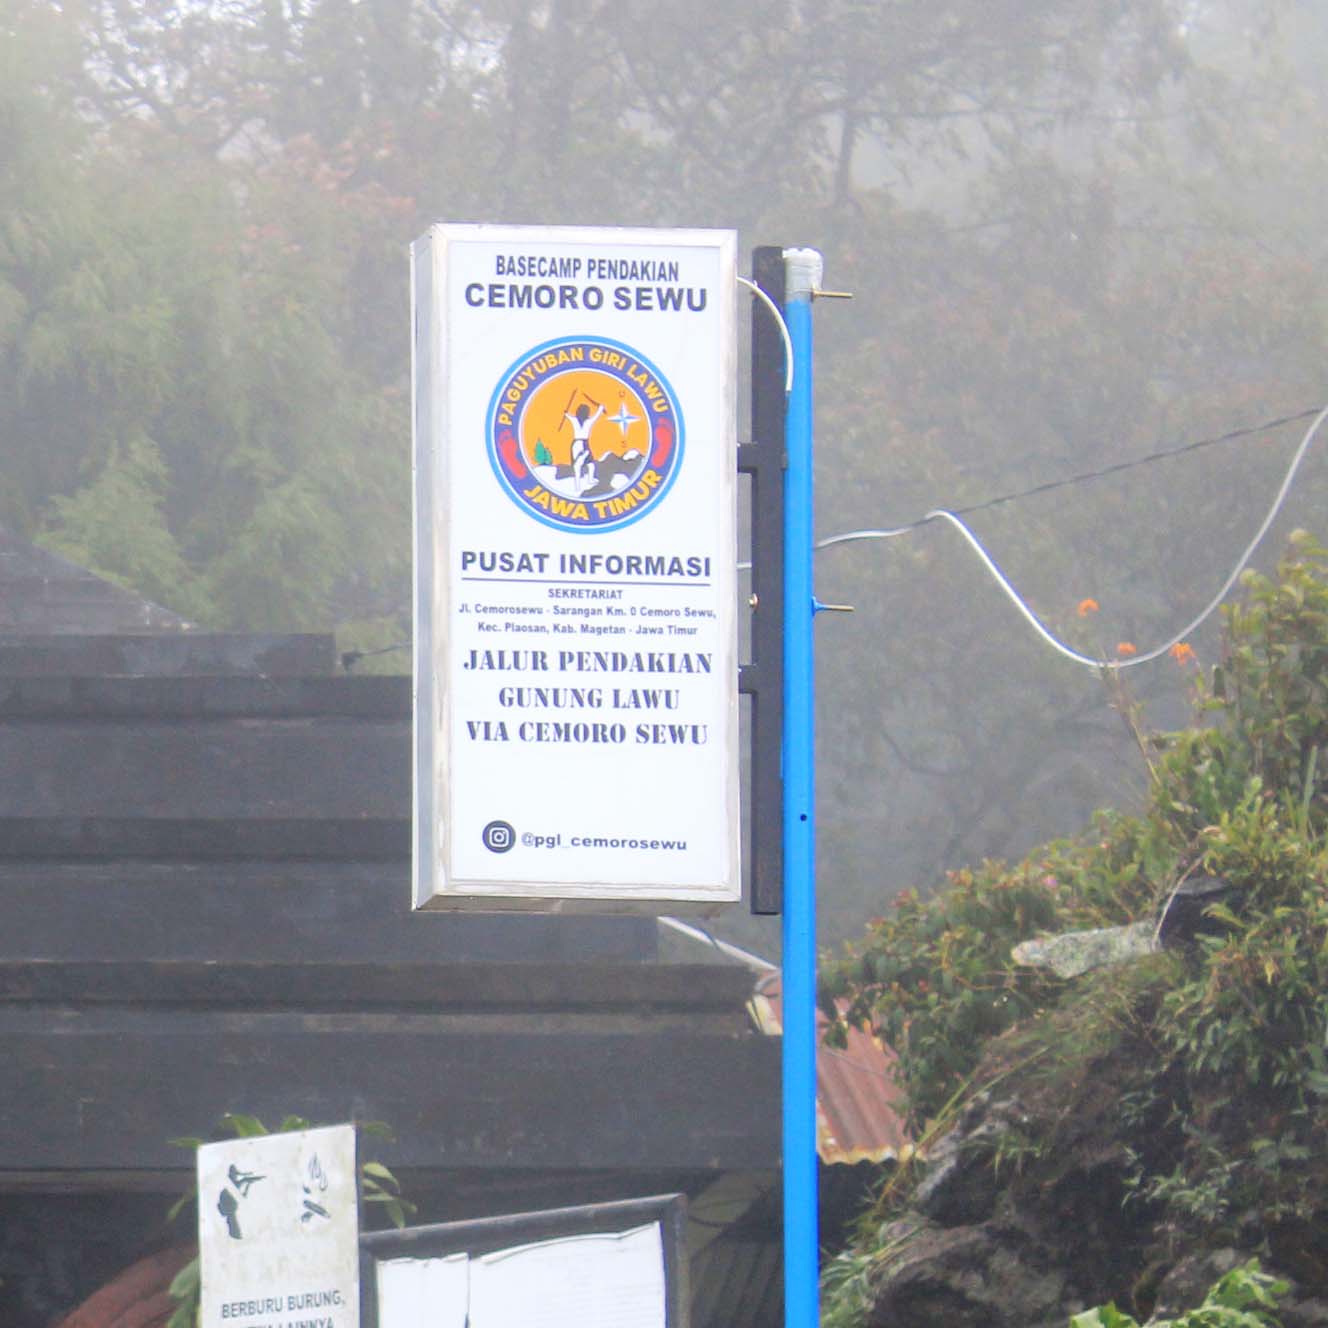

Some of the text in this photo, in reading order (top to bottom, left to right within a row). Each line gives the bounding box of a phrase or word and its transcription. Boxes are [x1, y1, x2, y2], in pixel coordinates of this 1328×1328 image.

[496, 255, 680, 282] BASECAMP PENDAKIAN
[465, 283, 707, 312] CEMORO SEWU
[498, 347, 669, 425] PAGUYUBAN GIRI LAWU
[524, 469, 663, 520] JAWA TIMUR
[461, 551, 711, 577] PUSAT INFORMASI
[548, 588, 623, 600] SEKRETARIAT
[474, 603, 543, 615] Cemorosewu
[553, 605, 603, 618] Sarangan
[606, 605, 627, 616] Km.
[640, 606, 681, 618] Cemoro
[684, 607, 717, 620] Sewu,
[477, 622, 501, 633] Kec.
[553, 623, 577, 634] Kab.
[580, 624, 626, 636] Magetan
[635, 625, 664, 636] Jawa
[668, 625, 698, 636] Timur
[463, 650, 713, 674] JALUR PENDAKIAN
[498, 687, 680, 710] GUNUNG LAWU
[466, 721, 709, 746] VIA CEMORO SEWU
[521, 831, 688, 852] @pgl_cemorosewu
[222, 1298, 284, 1319] BERBURU
